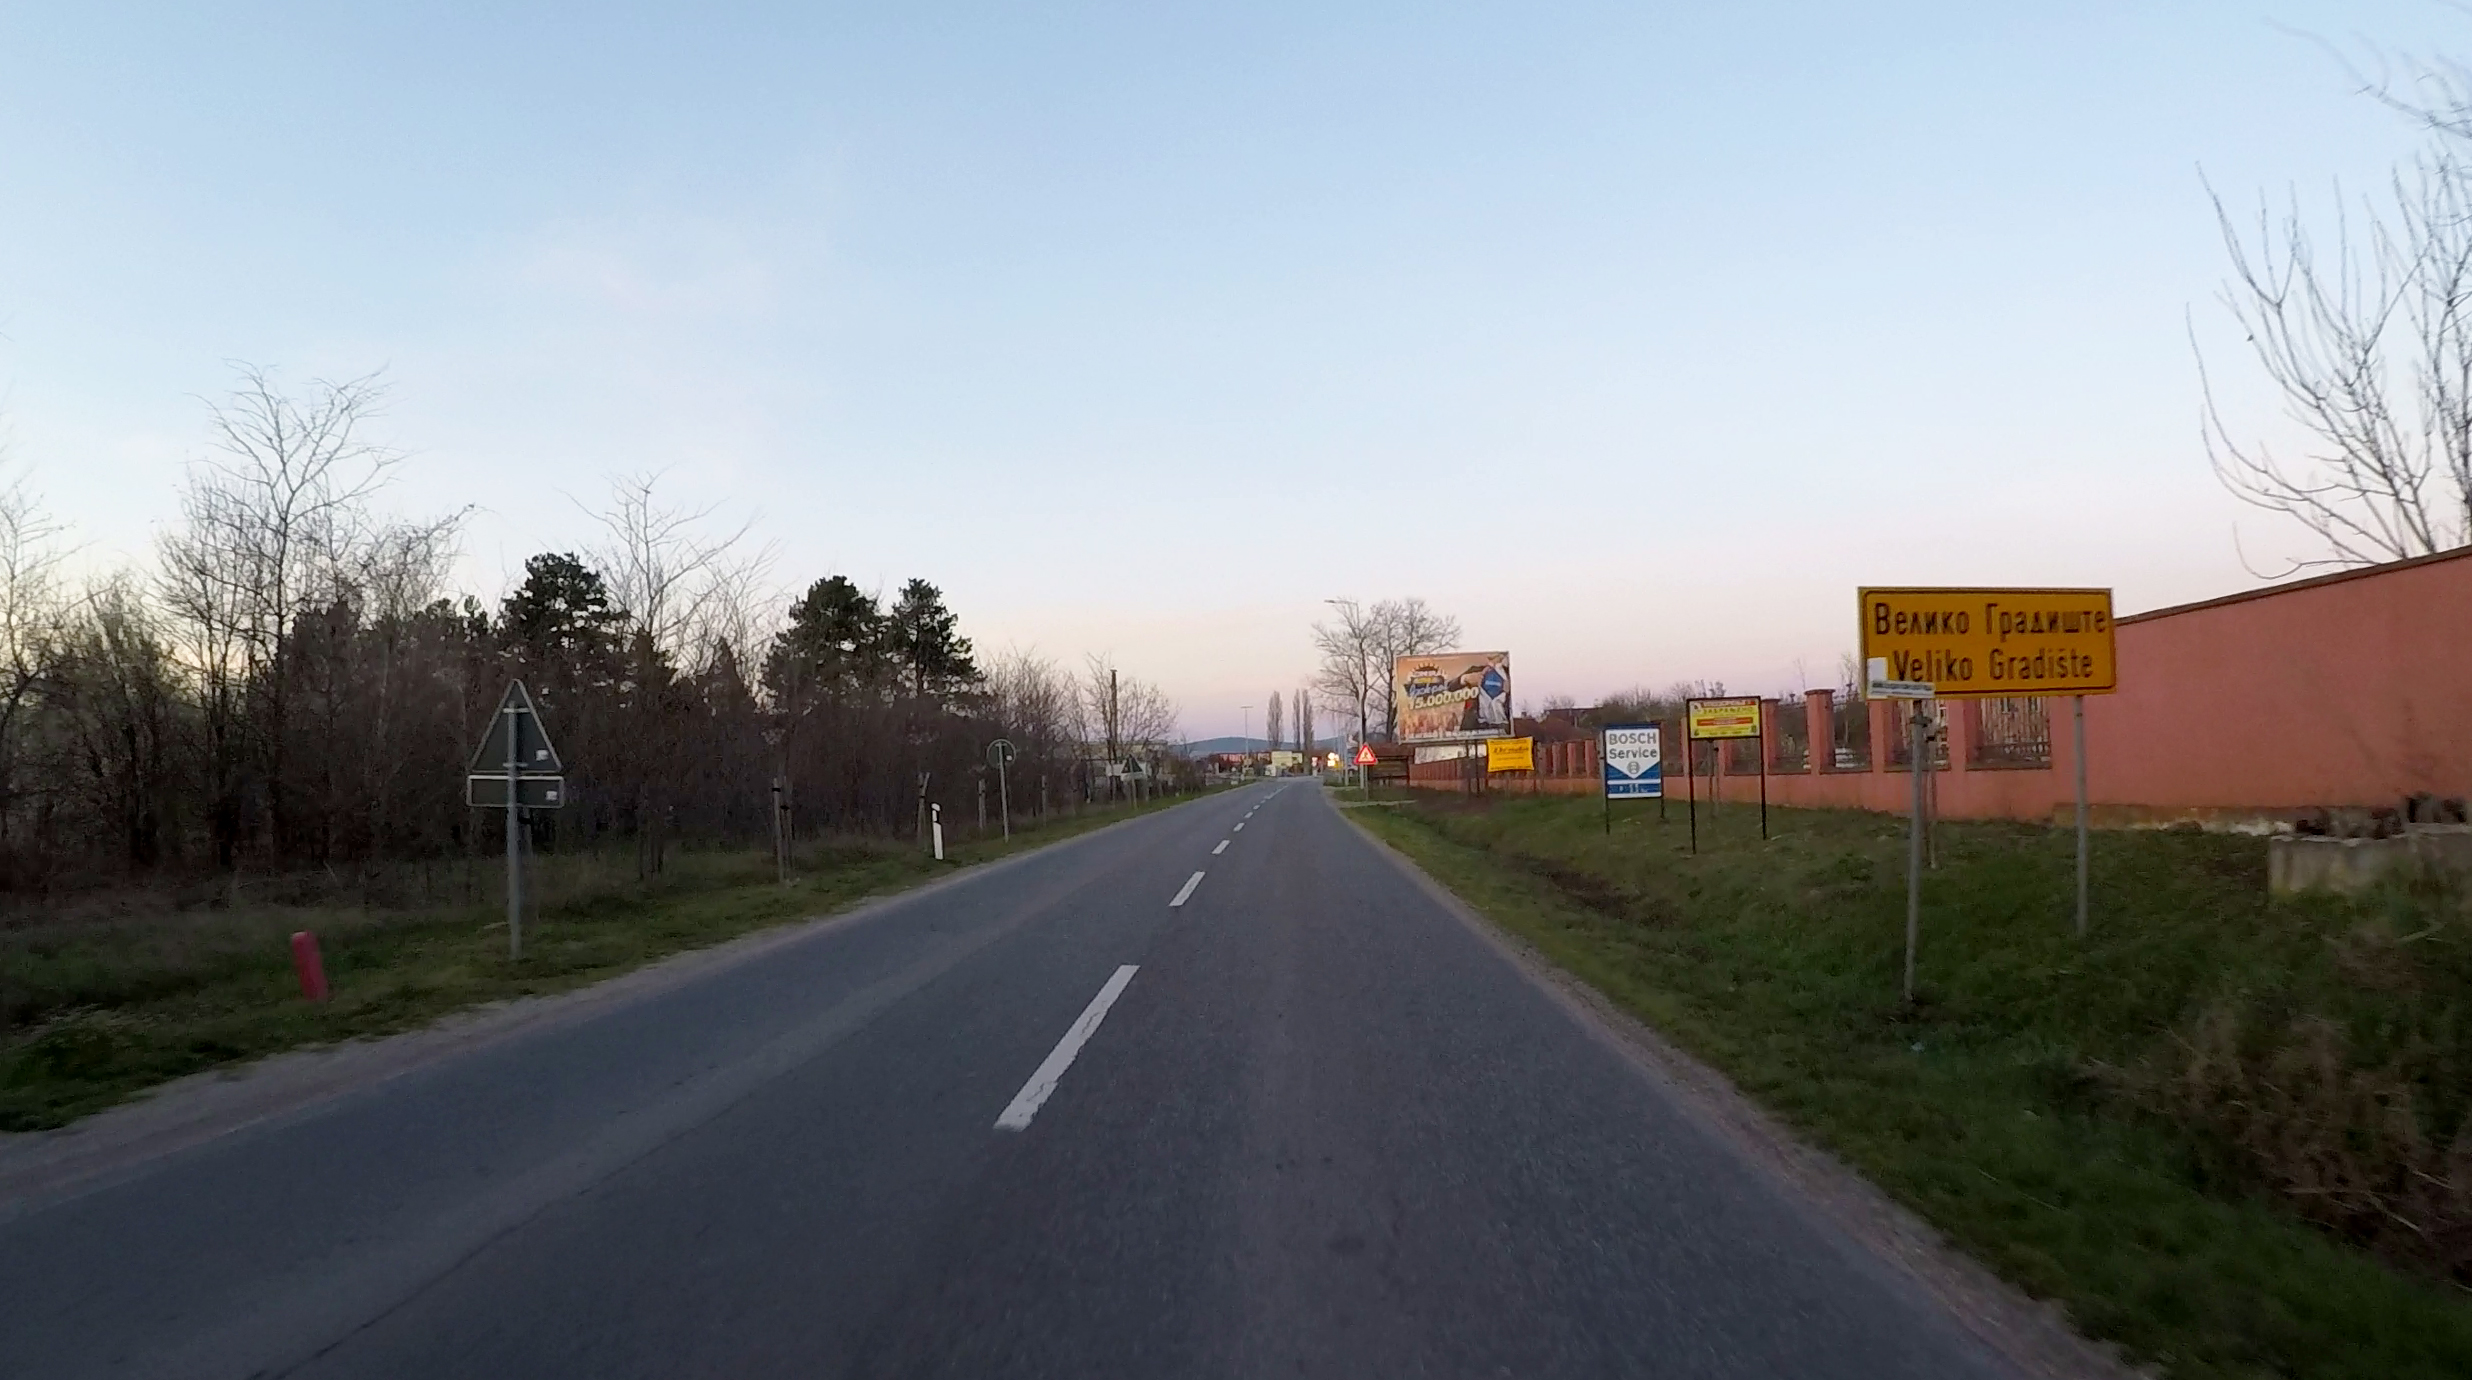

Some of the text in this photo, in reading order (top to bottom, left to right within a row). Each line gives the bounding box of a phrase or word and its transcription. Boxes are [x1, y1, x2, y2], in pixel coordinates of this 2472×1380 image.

[1875, 602, 2107, 643] Велико Градиште
[1894, 648, 2094, 682] Veliko Gradište
[1609, 732, 1657, 745] BOSCH
[1609, 747, 1657, 759] Service
